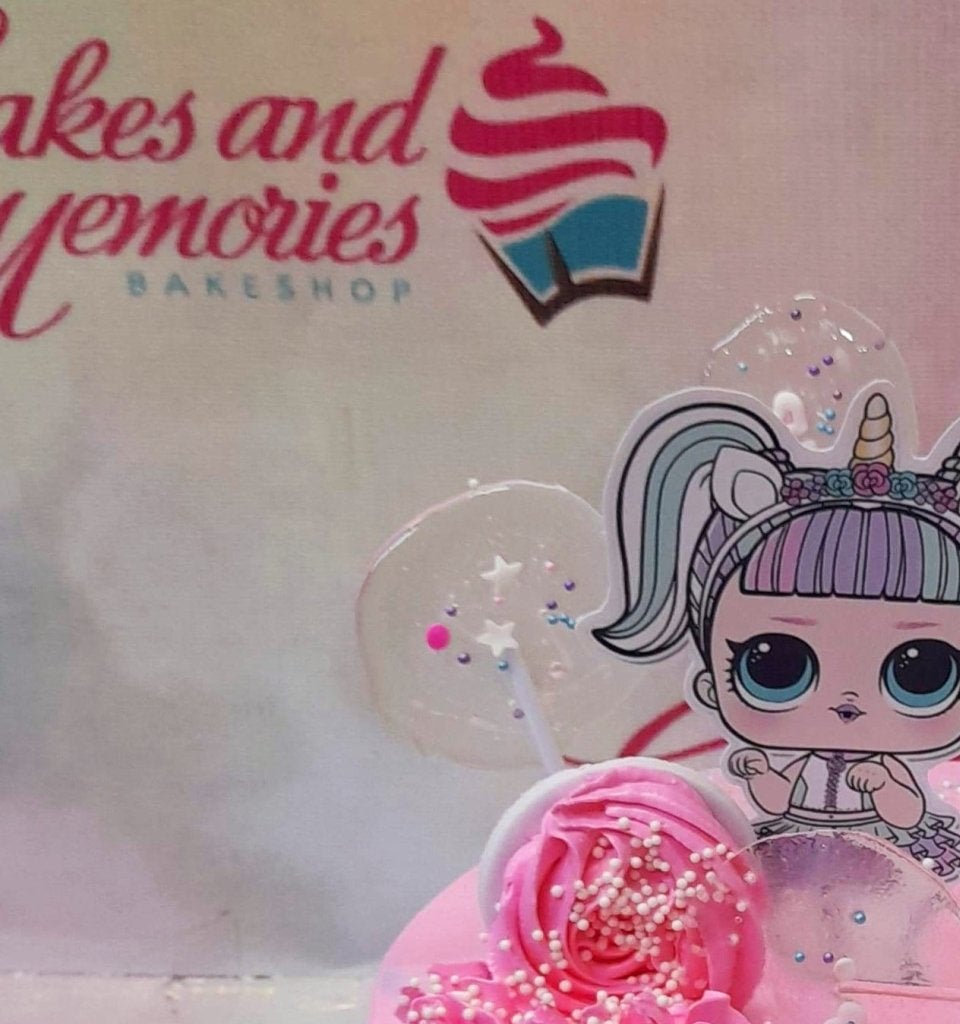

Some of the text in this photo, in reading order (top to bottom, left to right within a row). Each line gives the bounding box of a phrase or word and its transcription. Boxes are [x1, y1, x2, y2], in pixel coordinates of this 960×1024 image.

[0, 8, 447, 168] akes and
[126, 270, 411, 303] BAKESHOP
